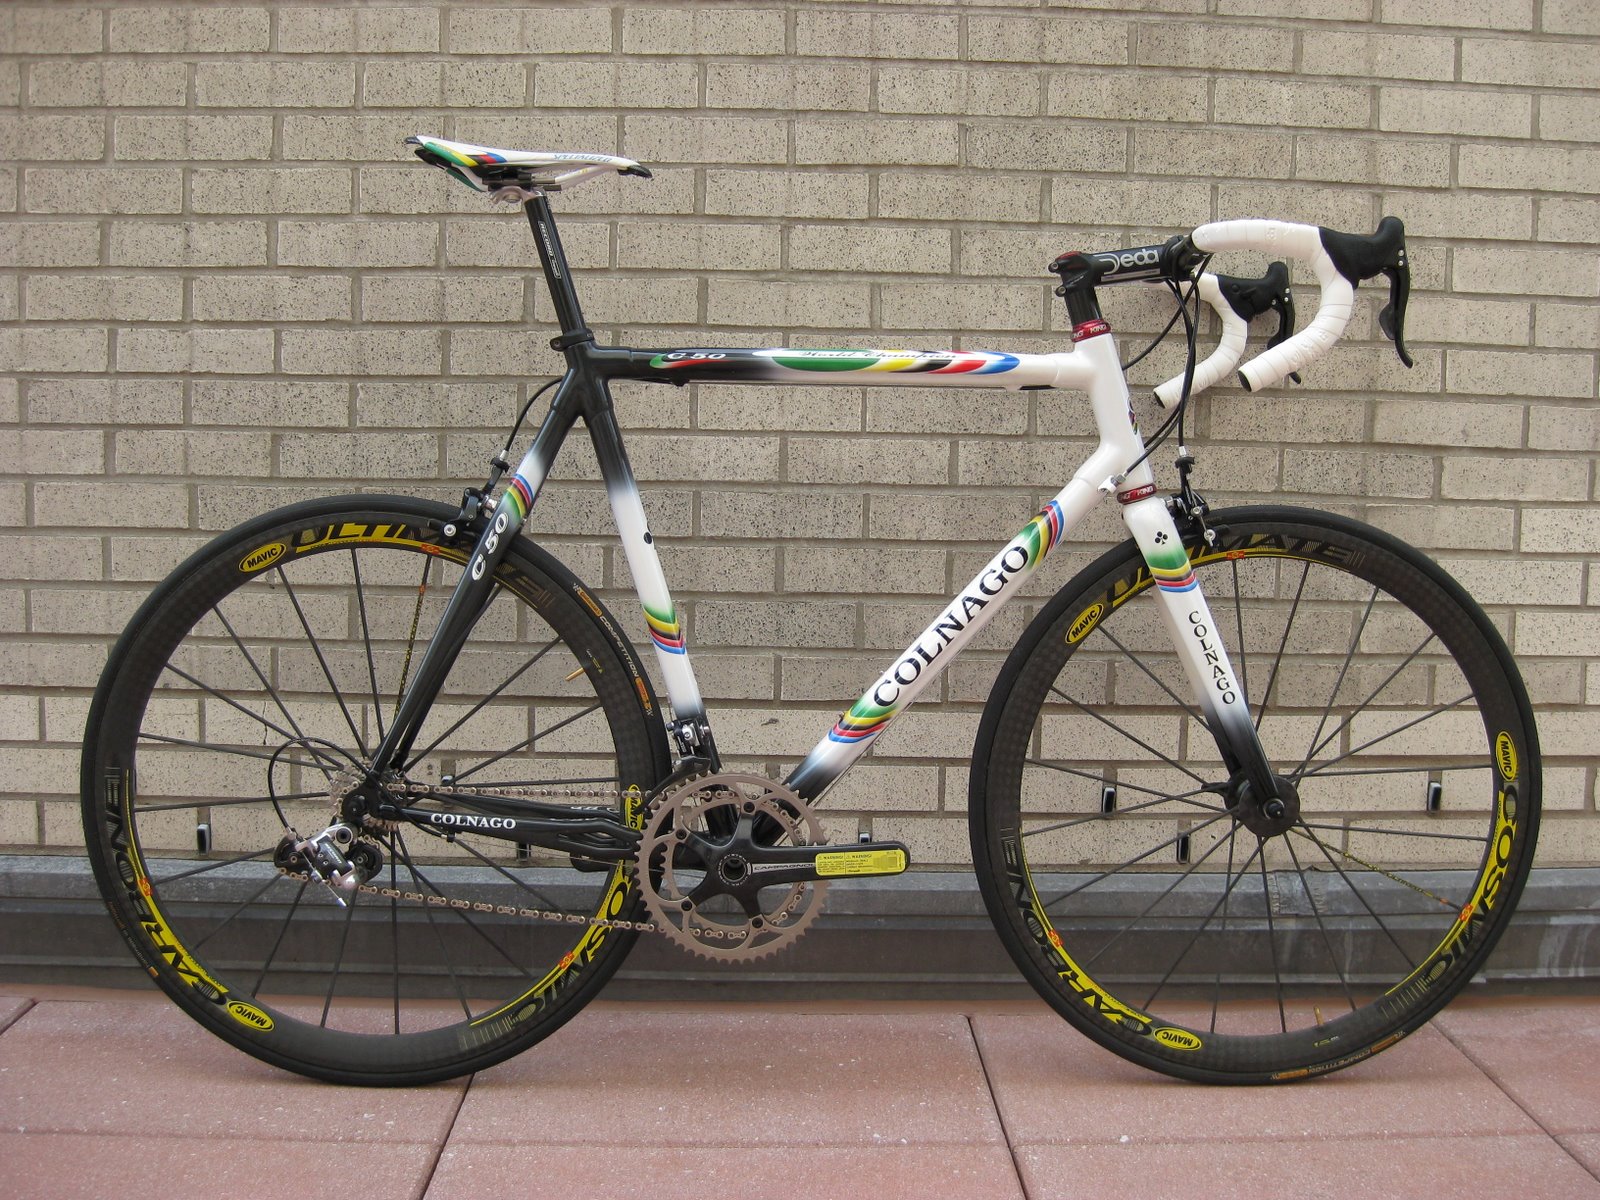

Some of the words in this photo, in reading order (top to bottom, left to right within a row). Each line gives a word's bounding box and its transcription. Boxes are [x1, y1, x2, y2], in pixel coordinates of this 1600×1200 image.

[689, 352, 727, 360] 50
[484, 512, 509, 555] 50
[246, 547, 279, 568] MAVIC
[873, 545, 1029, 708] COLNAGO
[1071, 608, 1099, 639] MAVIC
[1188, 610, 1236, 705] COLNAGO
[430, 812, 517, 830] COLNAGO
[754, 862, 816, 871] CAMPAGNOL
[234, 1004, 268, 1027] MAVIC
[1161, 1030, 1195, 1047] MAVIC
